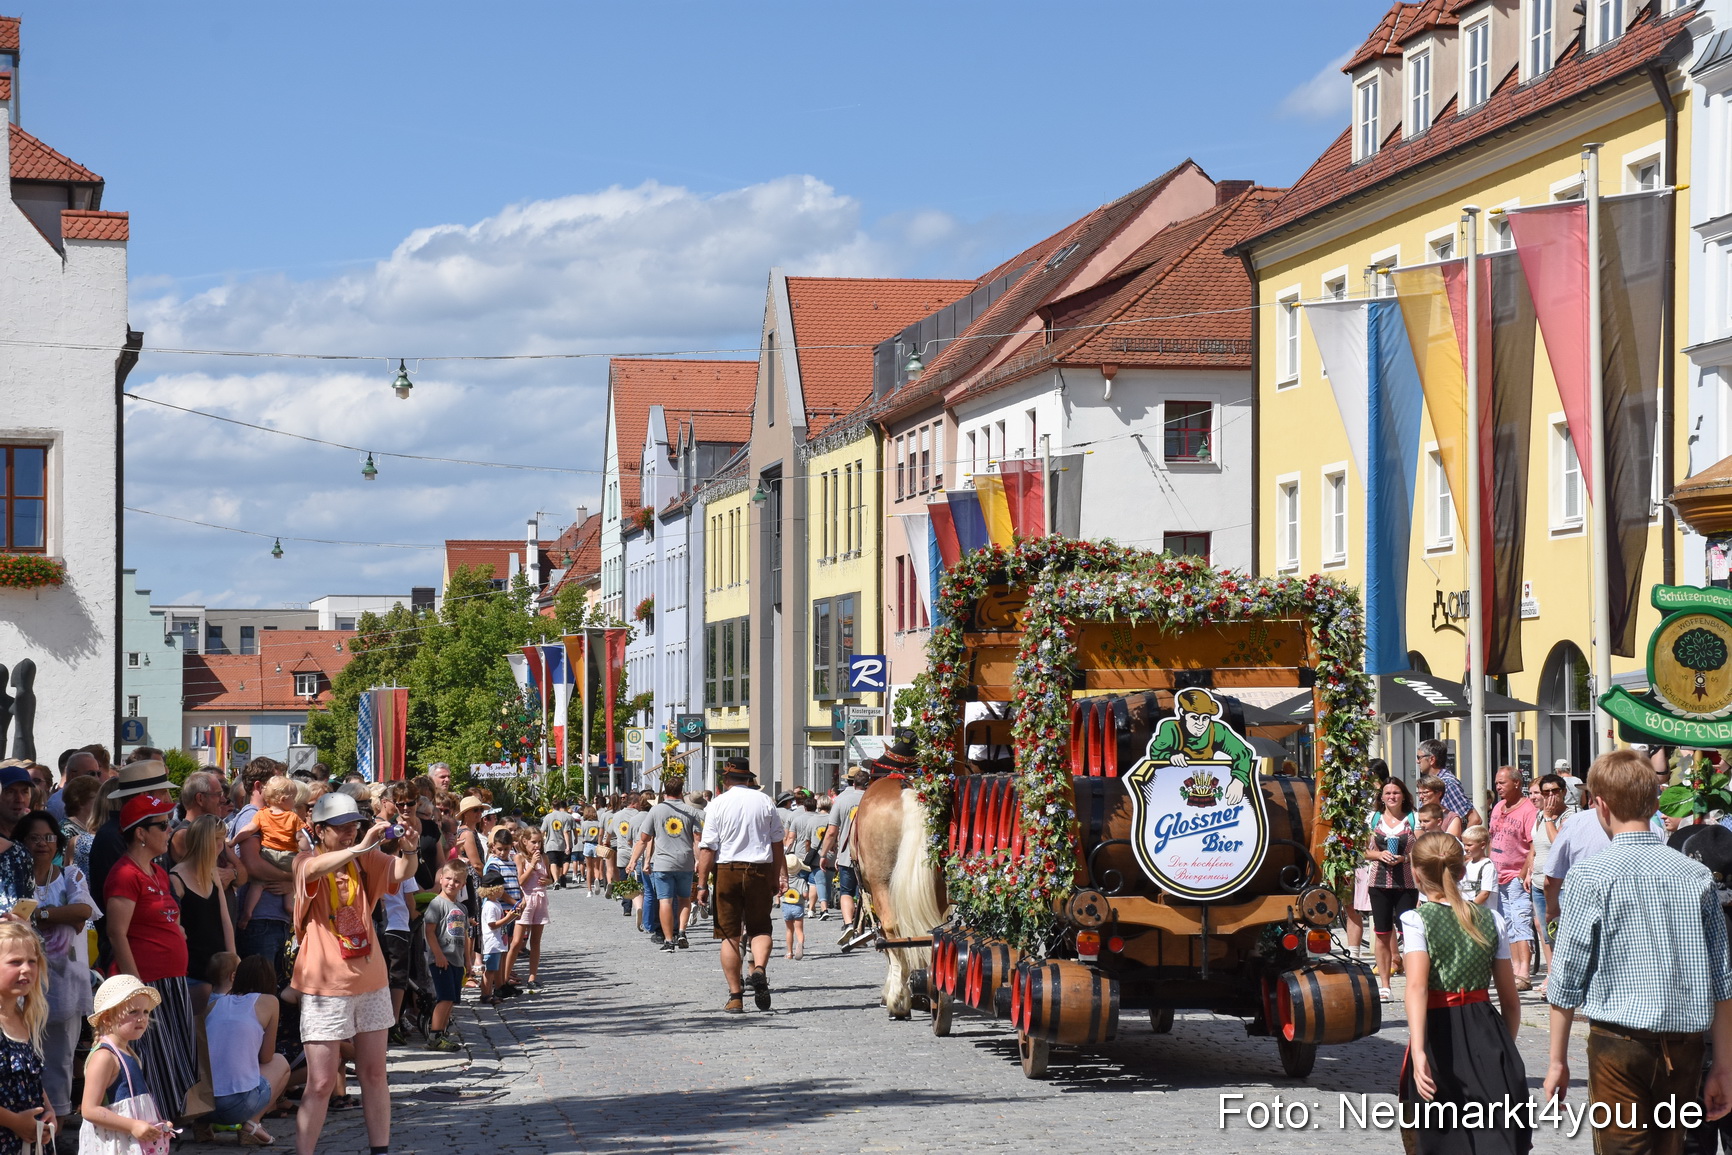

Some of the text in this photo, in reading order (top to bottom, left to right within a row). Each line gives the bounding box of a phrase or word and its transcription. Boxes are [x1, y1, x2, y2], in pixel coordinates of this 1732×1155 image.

[1659, 589, 1732, 606] Schützenverei
[1677, 618, 1729, 634] WOFFENBACH
[1645, 712, 1732, 739] WOFFENB
[1154, 805, 1244, 855] Glossner
[1202, 832, 1244, 852] Bier
[1167, 855, 1234, 871] Der hochfeine
[1174, 868, 1229, 884] Biergenuss
